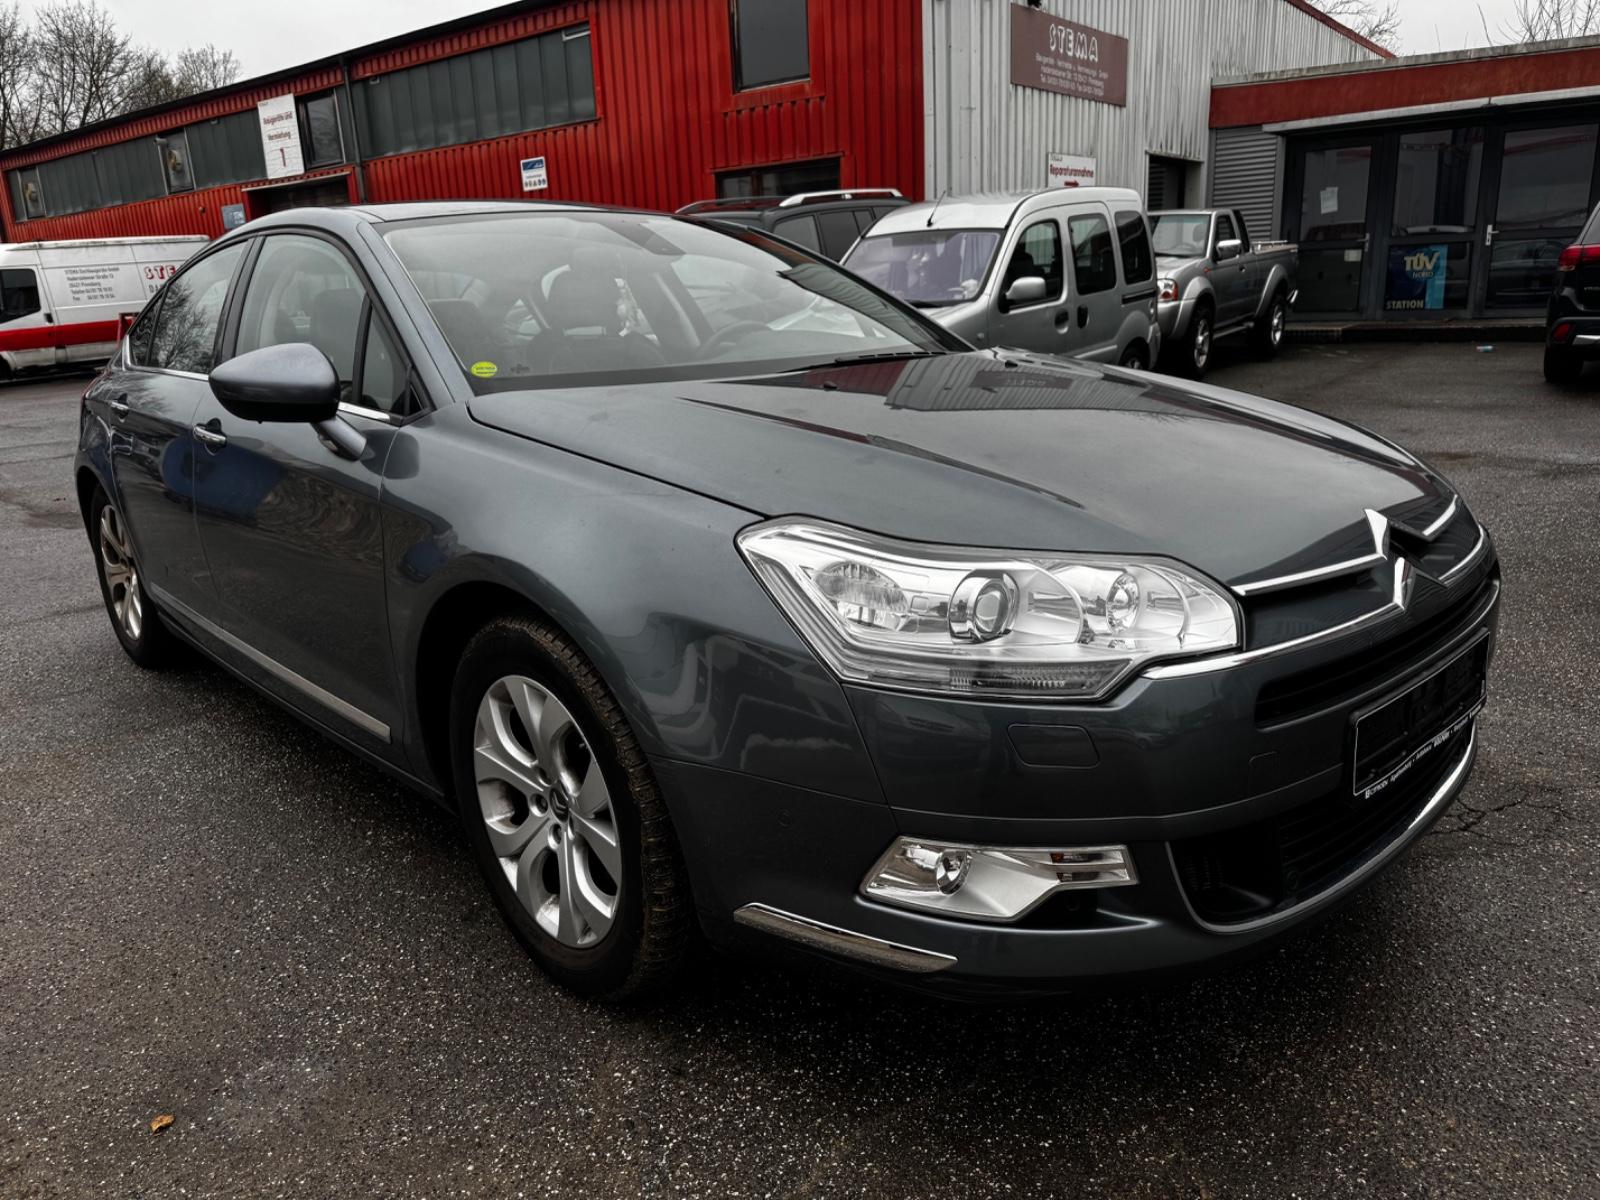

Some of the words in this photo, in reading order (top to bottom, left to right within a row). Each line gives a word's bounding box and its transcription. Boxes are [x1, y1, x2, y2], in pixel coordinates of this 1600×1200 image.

[1049, 23, 1099, 62] STEMA
[1404, 252, 1440, 272] TÜV
[1386, 299, 1424, 310] STATION
